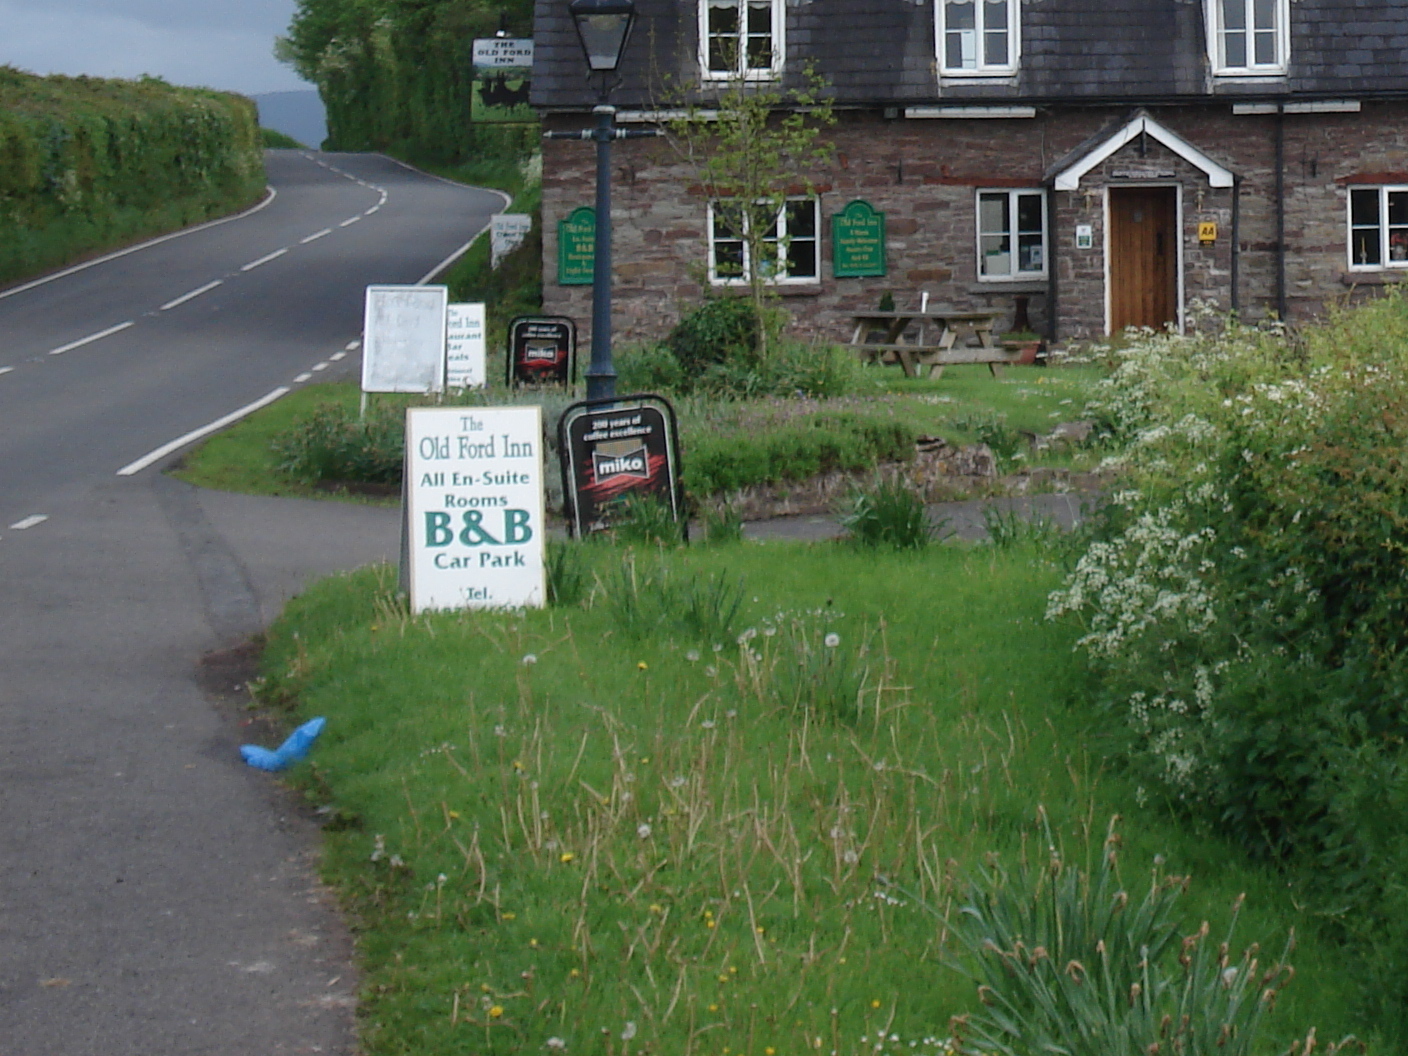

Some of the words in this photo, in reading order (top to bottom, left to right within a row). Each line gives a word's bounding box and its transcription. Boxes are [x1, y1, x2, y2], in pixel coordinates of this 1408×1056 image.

[1201, 226, 1214, 235] AA
[527, 348, 554, 358] miko
[460, 415, 484, 432] The
[609, 417, 631, 429] years
[632, 414, 642, 424] of
[609, 426, 652, 438] excellence
[420, 435, 450, 460] Old
[457, 434, 496, 459] Ford
[502, 434, 533, 458] Inn
[599, 457, 643, 475] miko
[420, 472, 445, 487] All
[452, 470, 530, 486] En-Suite
[445, 494, 508, 508] Rooms
[424, 509, 533, 548] B&B
[434, 552, 471, 569] Car
[480, 550, 526, 568] Park
[466, 587, 493, 600] Tel.
